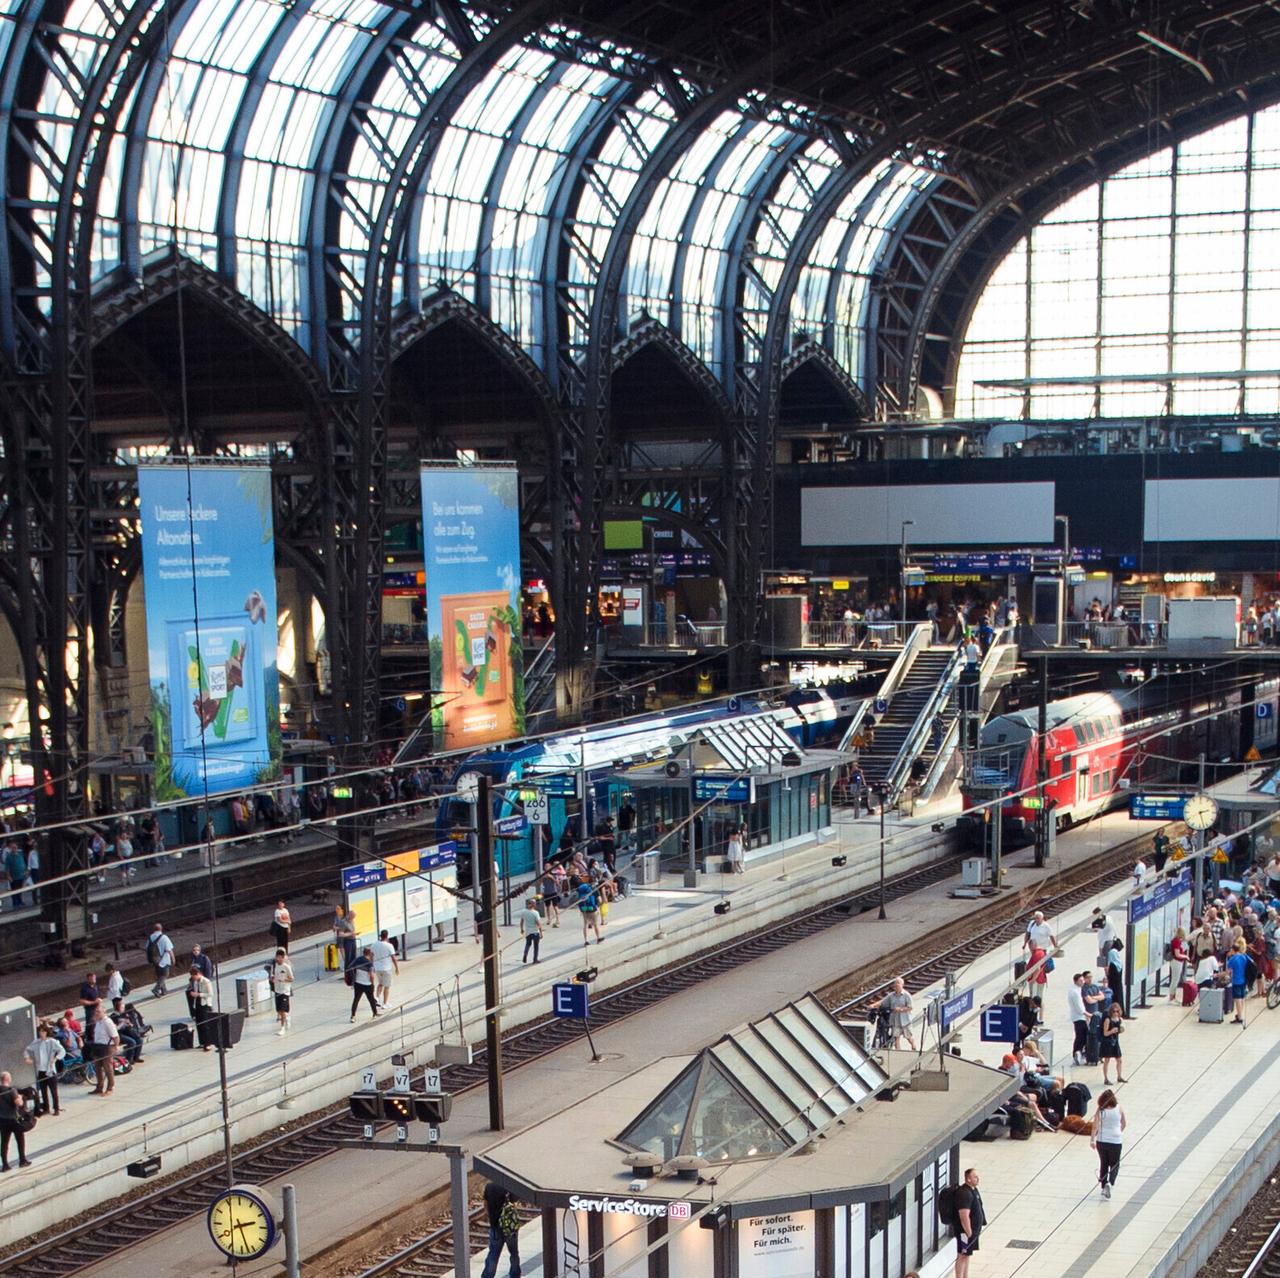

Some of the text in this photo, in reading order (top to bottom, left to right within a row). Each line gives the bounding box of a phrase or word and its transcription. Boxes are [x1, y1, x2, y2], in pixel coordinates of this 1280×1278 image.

[1258, 703, 1267, 717] D
[533, 809, 540, 820] 6
[557, 987, 573, 1013] E
[986, 1009, 1003, 1037] E
[569, 1195, 688, 1218] ServiceStore DB
[750, 1215, 794, 1227] Für sofort.
[762, 1225, 806, 1236] Für später.
[754, 1237, 792, 1248] Für mich.
